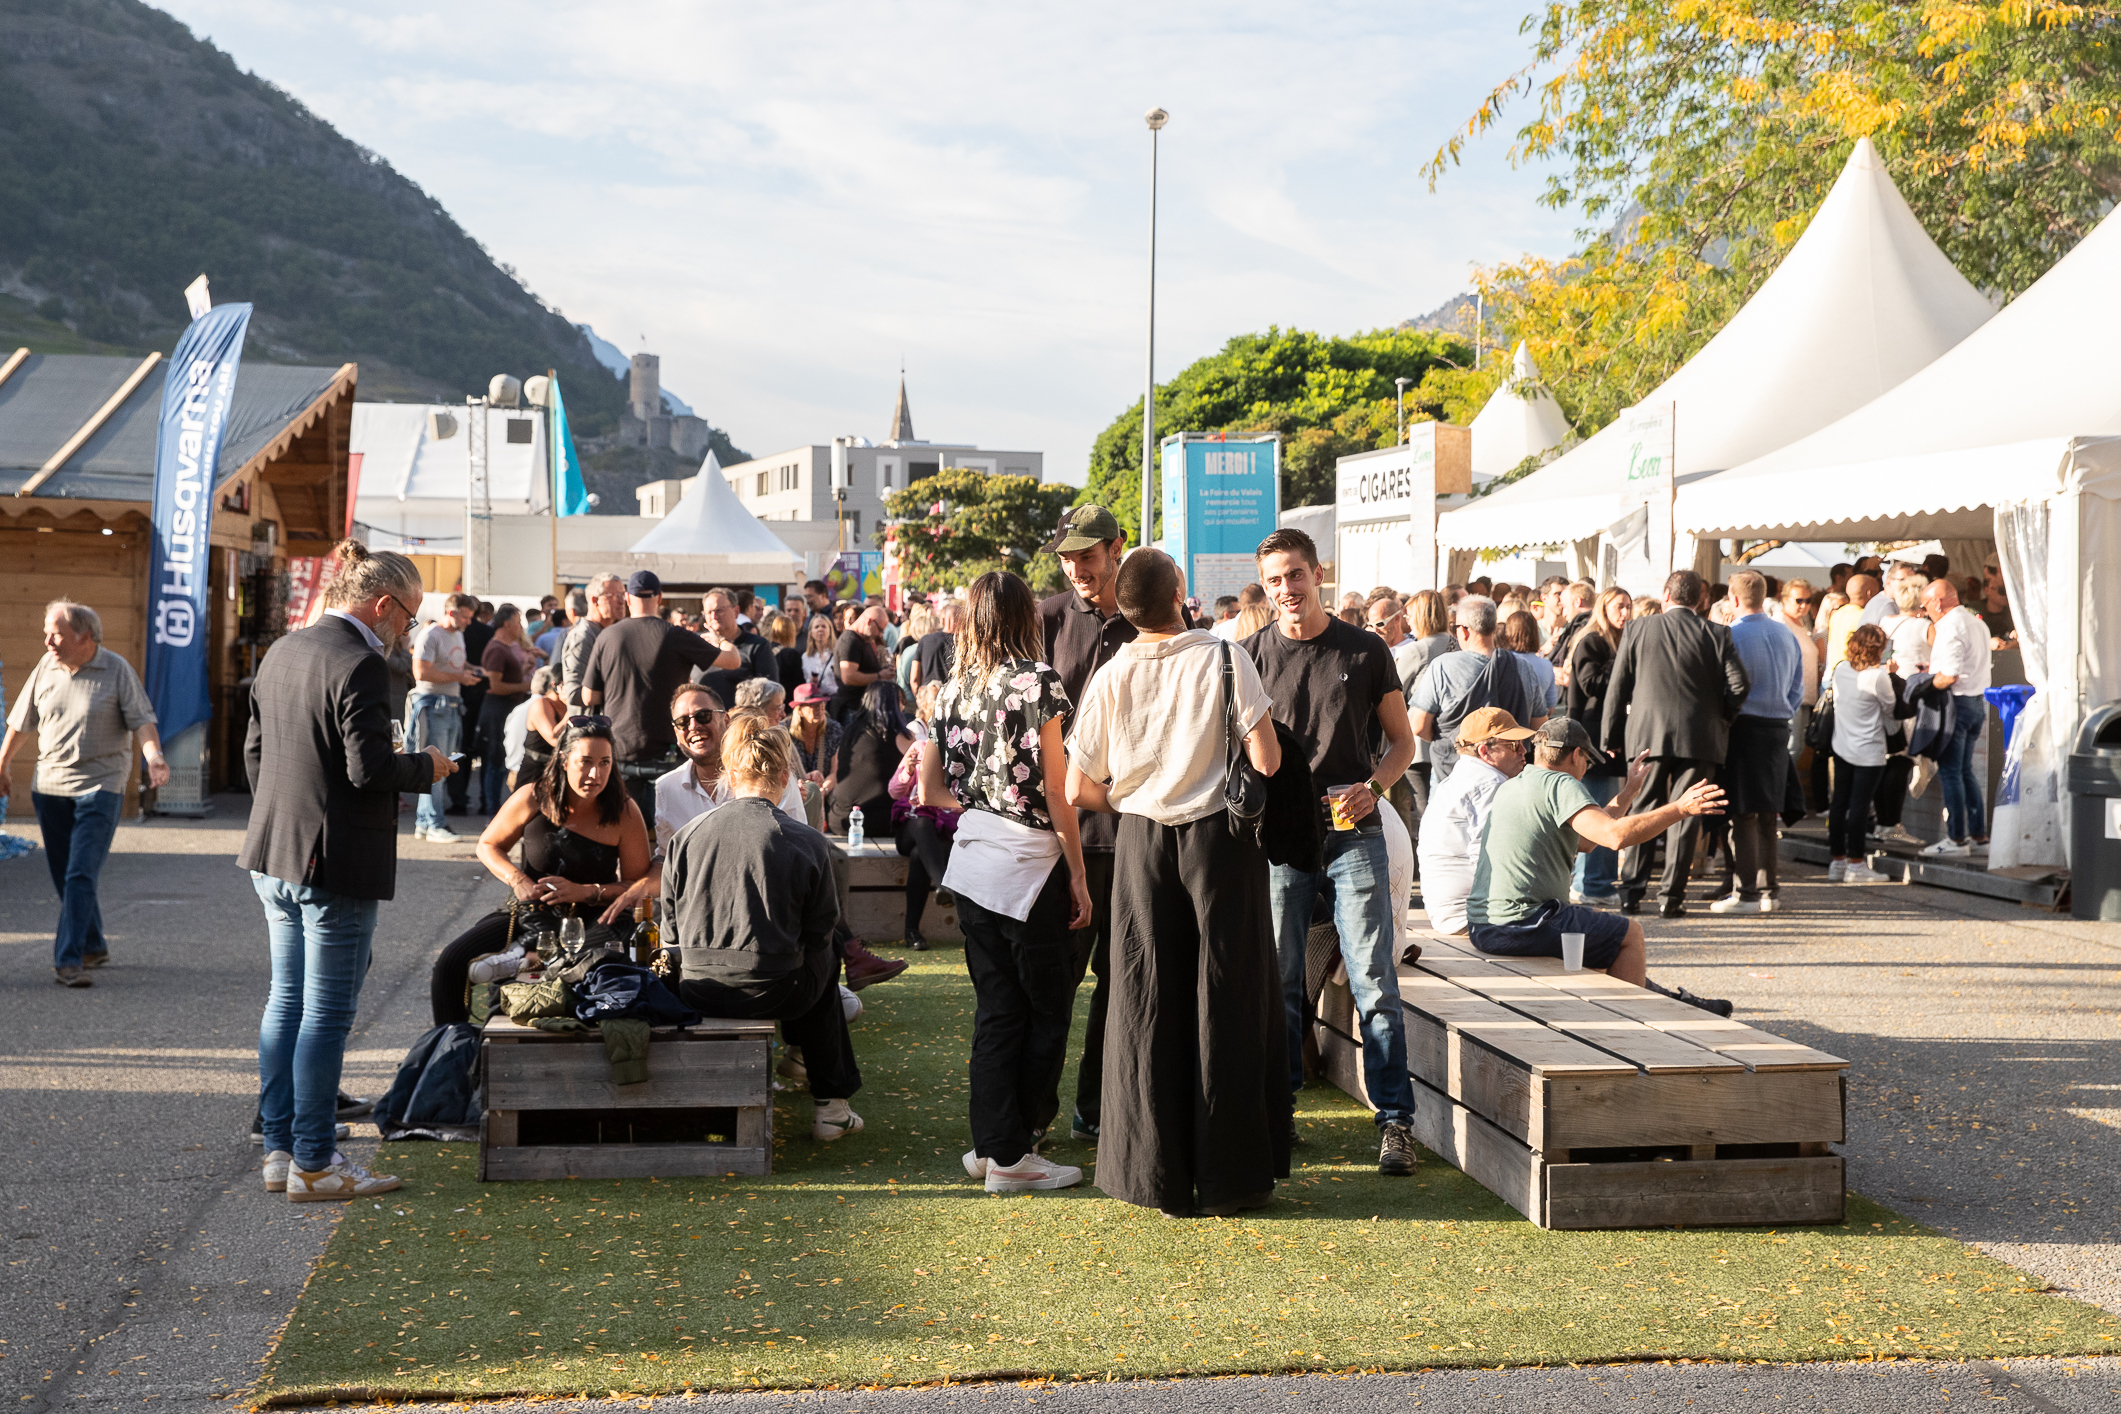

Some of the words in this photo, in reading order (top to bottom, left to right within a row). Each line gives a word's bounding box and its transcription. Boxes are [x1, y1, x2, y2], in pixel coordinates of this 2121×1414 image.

[209, 400, 224, 436] YOU
[217, 362, 232, 396] ARE
[161, 359, 215, 597] Husqvarna
[1210, 488, 1229, 496] Foire
[1230, 488, 1240, 496] du
[1241, 488, 1263, 496] Valais
[1360, 467, 1410, 503] CIGARES
